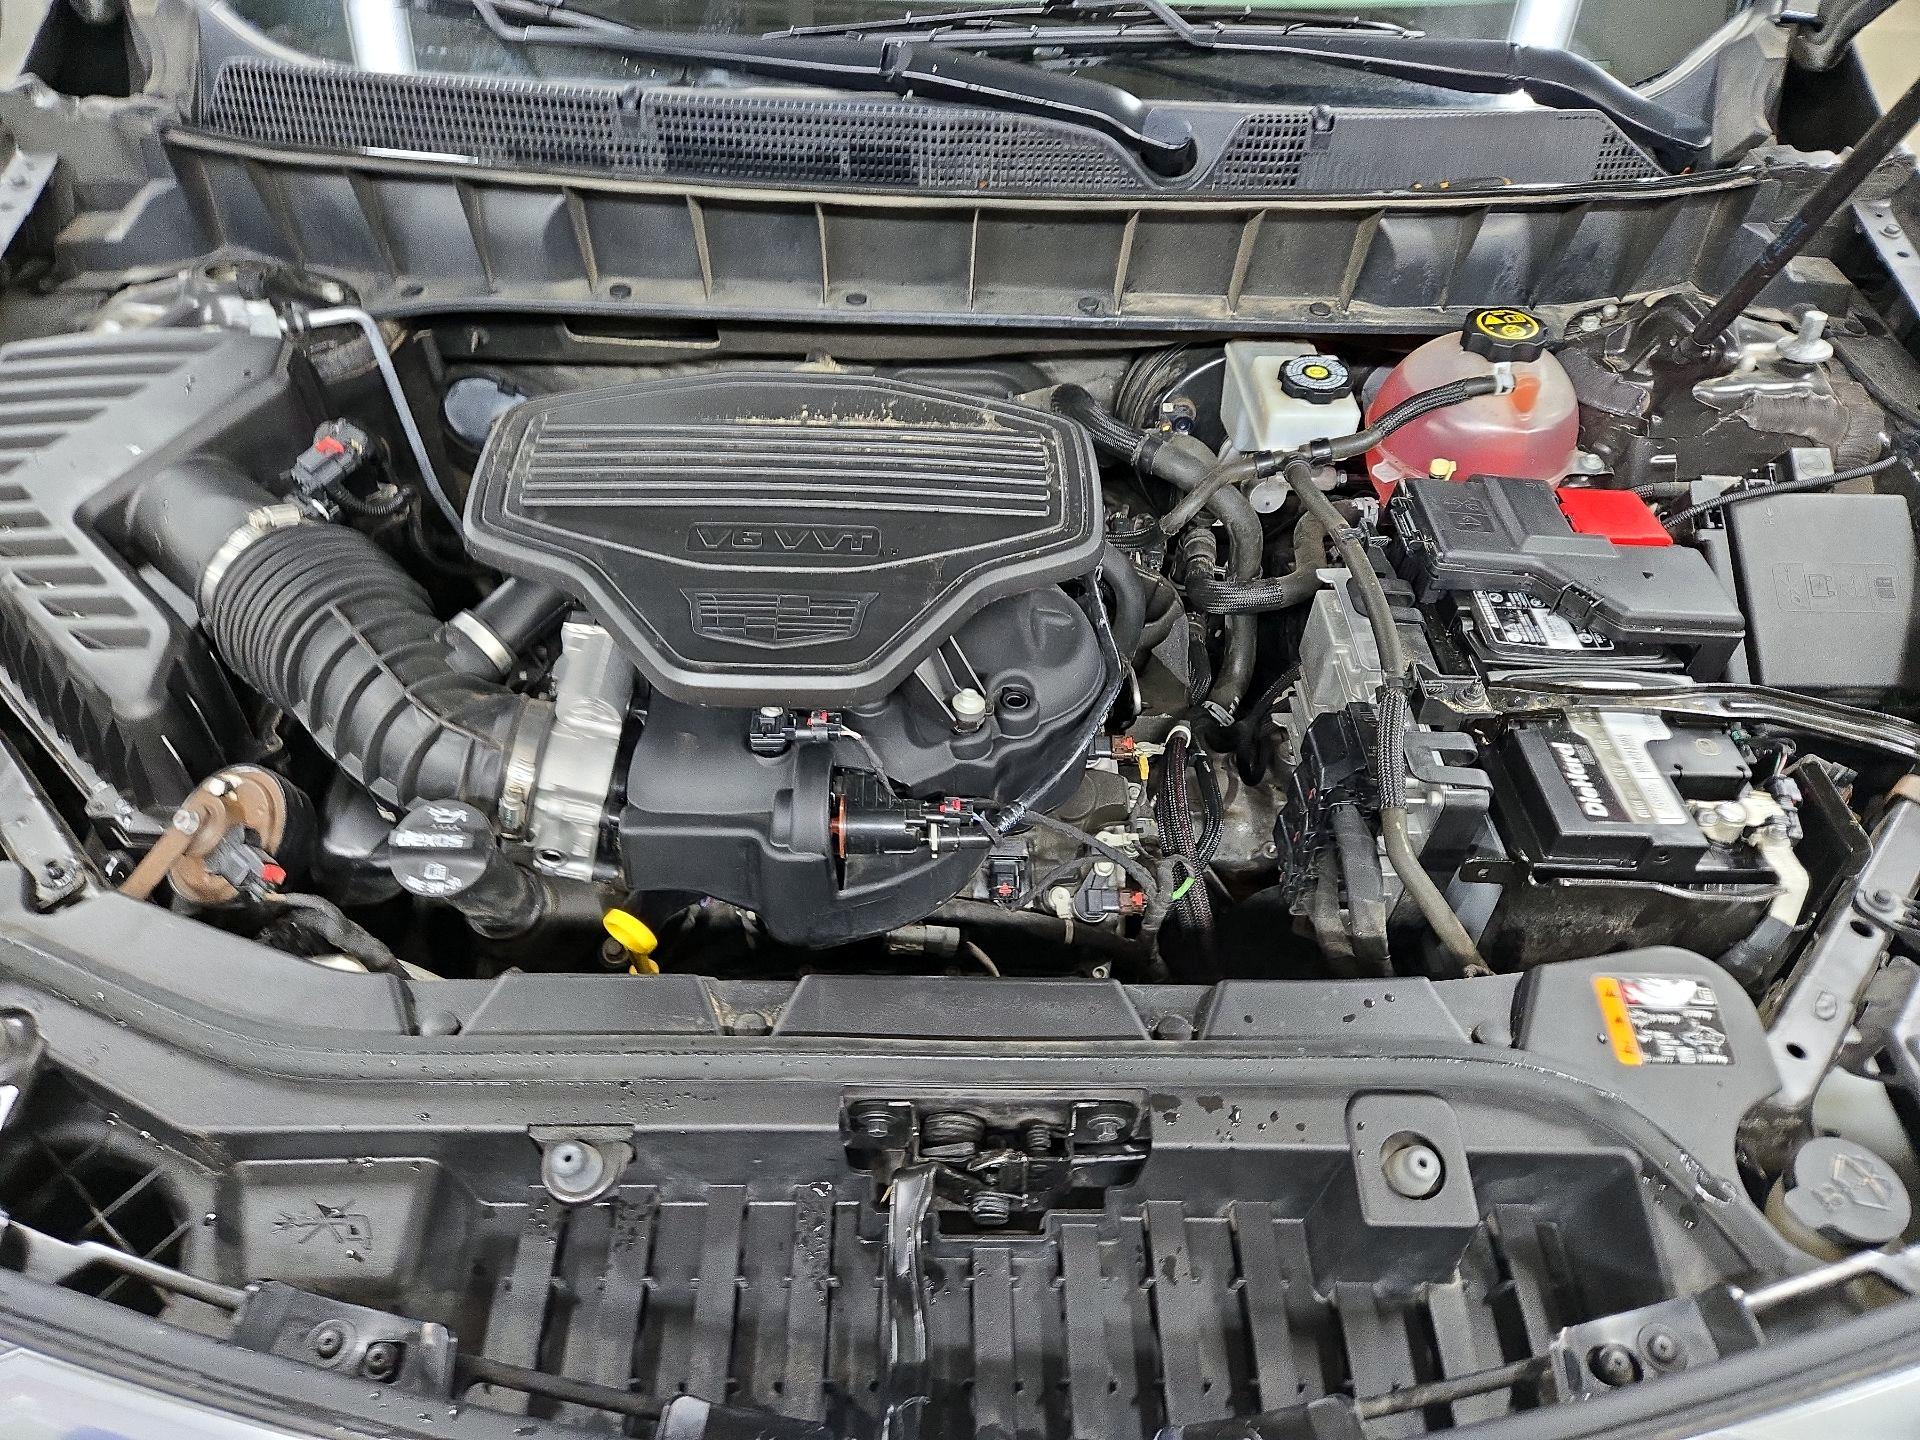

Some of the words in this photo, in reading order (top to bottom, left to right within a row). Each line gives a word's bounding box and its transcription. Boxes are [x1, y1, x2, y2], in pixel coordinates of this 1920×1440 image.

[696, 529, 763, 549] V6
[774, 529, 873, 551] VVT
[1551, 741, 1609, 818] DieHard
